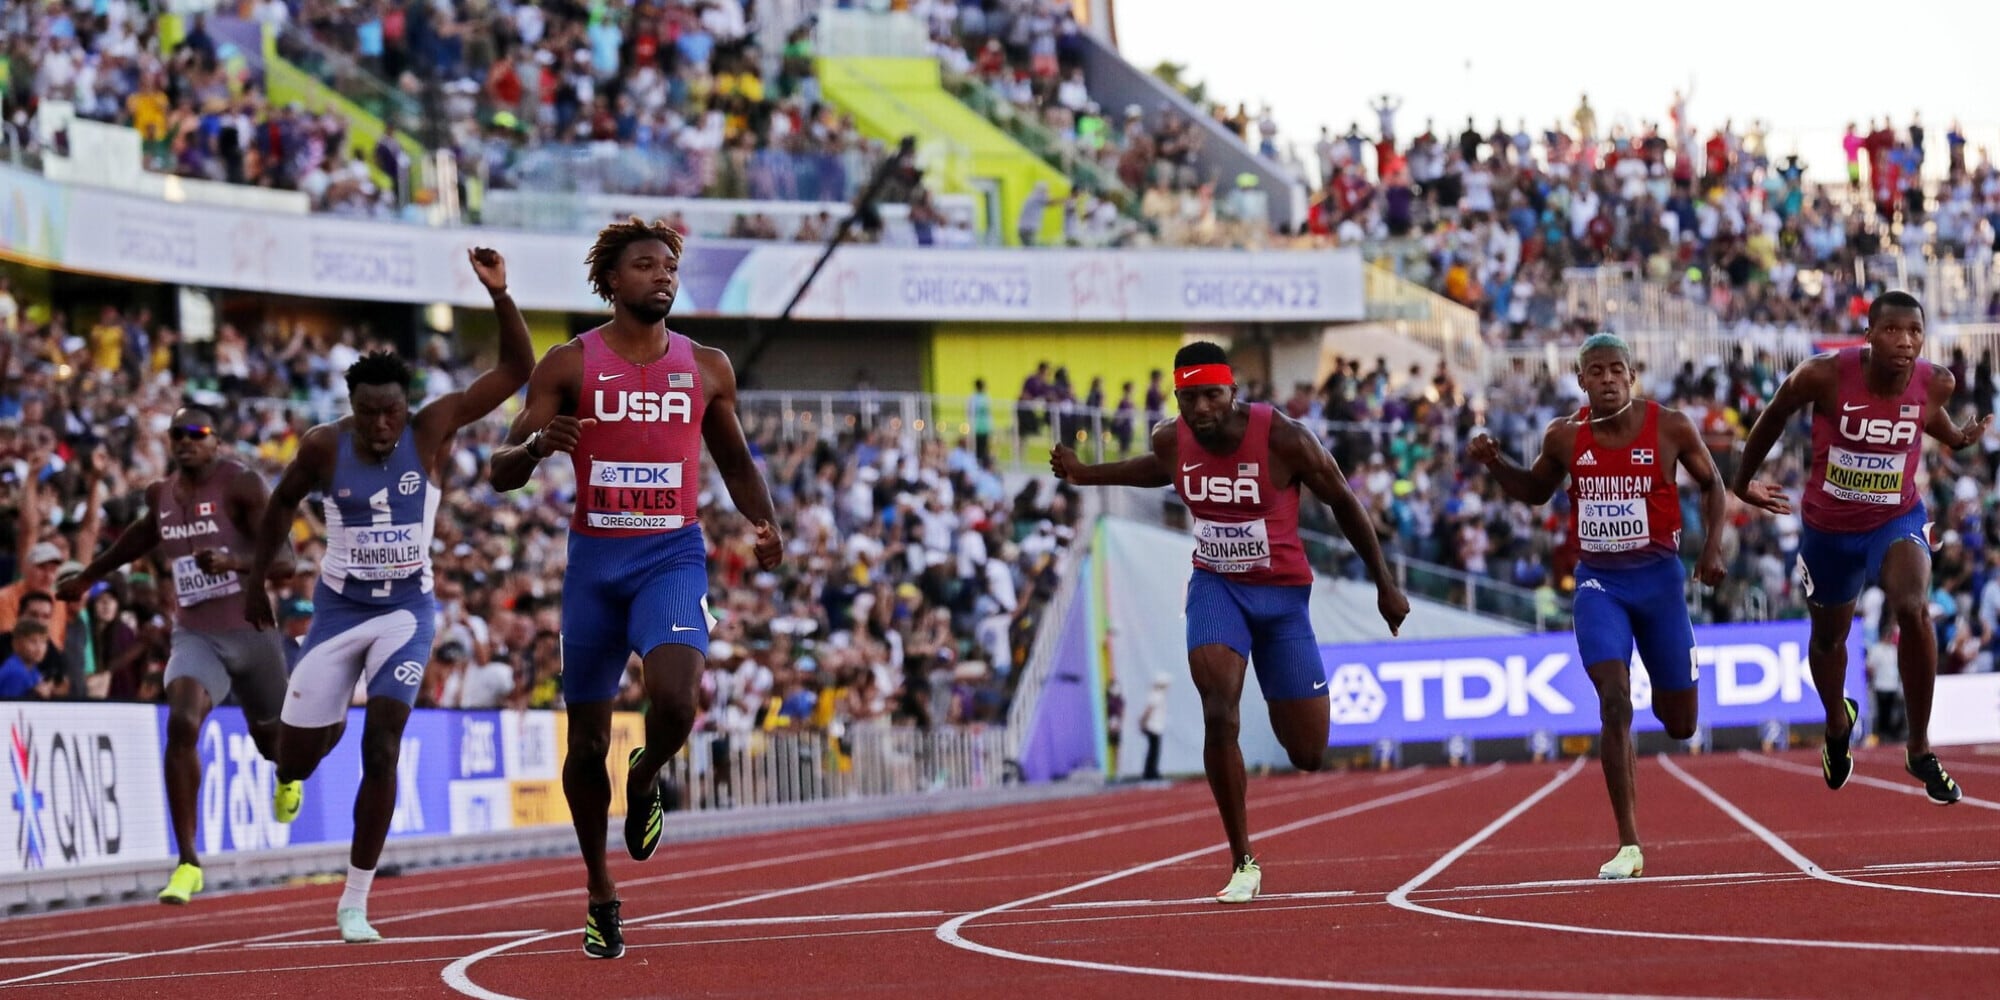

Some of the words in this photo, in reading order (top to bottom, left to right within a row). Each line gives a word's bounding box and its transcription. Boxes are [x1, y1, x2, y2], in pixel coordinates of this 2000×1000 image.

[903, 276, 1031, 307] OREGON22
[1183, 279, 1321, 308] OREGON22
[595, 390, 691, 423] USA
[1840, 415, 1917, 445] USA
[1853, 456, 1895, 470] TDK
[617, 467, 669, 484] TDK
[1578, 476, 1652, 493] DOMINICAN
[1830, 466, 1900, 490] KNIGHTON
[594, 489, 611, 510] N.
[618, 489, 676, 510] LYLES
[1183, 475, 1261, 504] USA
[1834, 489, 1888, 503] OREGON22
[1593, 503, 1636, 517] TDK
[161, 520, 219, 540] CANADA
[601, 516, 666, 528] OREGON22
[1211, 525, 1254, 539] TDK
[1581, 520, 1643, 538] OGANDO
[369, 529, 411, 543] TDK
[350, 544, 420, 565] FAHNBULLEH
[1199, 540, 1266, 559] BEDNAREK
[1587, 541, 1637, 552] OREGON22
[1697, 640, 1821, 707] DK
[1377, 652, 1575, 723] TDK
[51, 732, 122, 864] QNB
